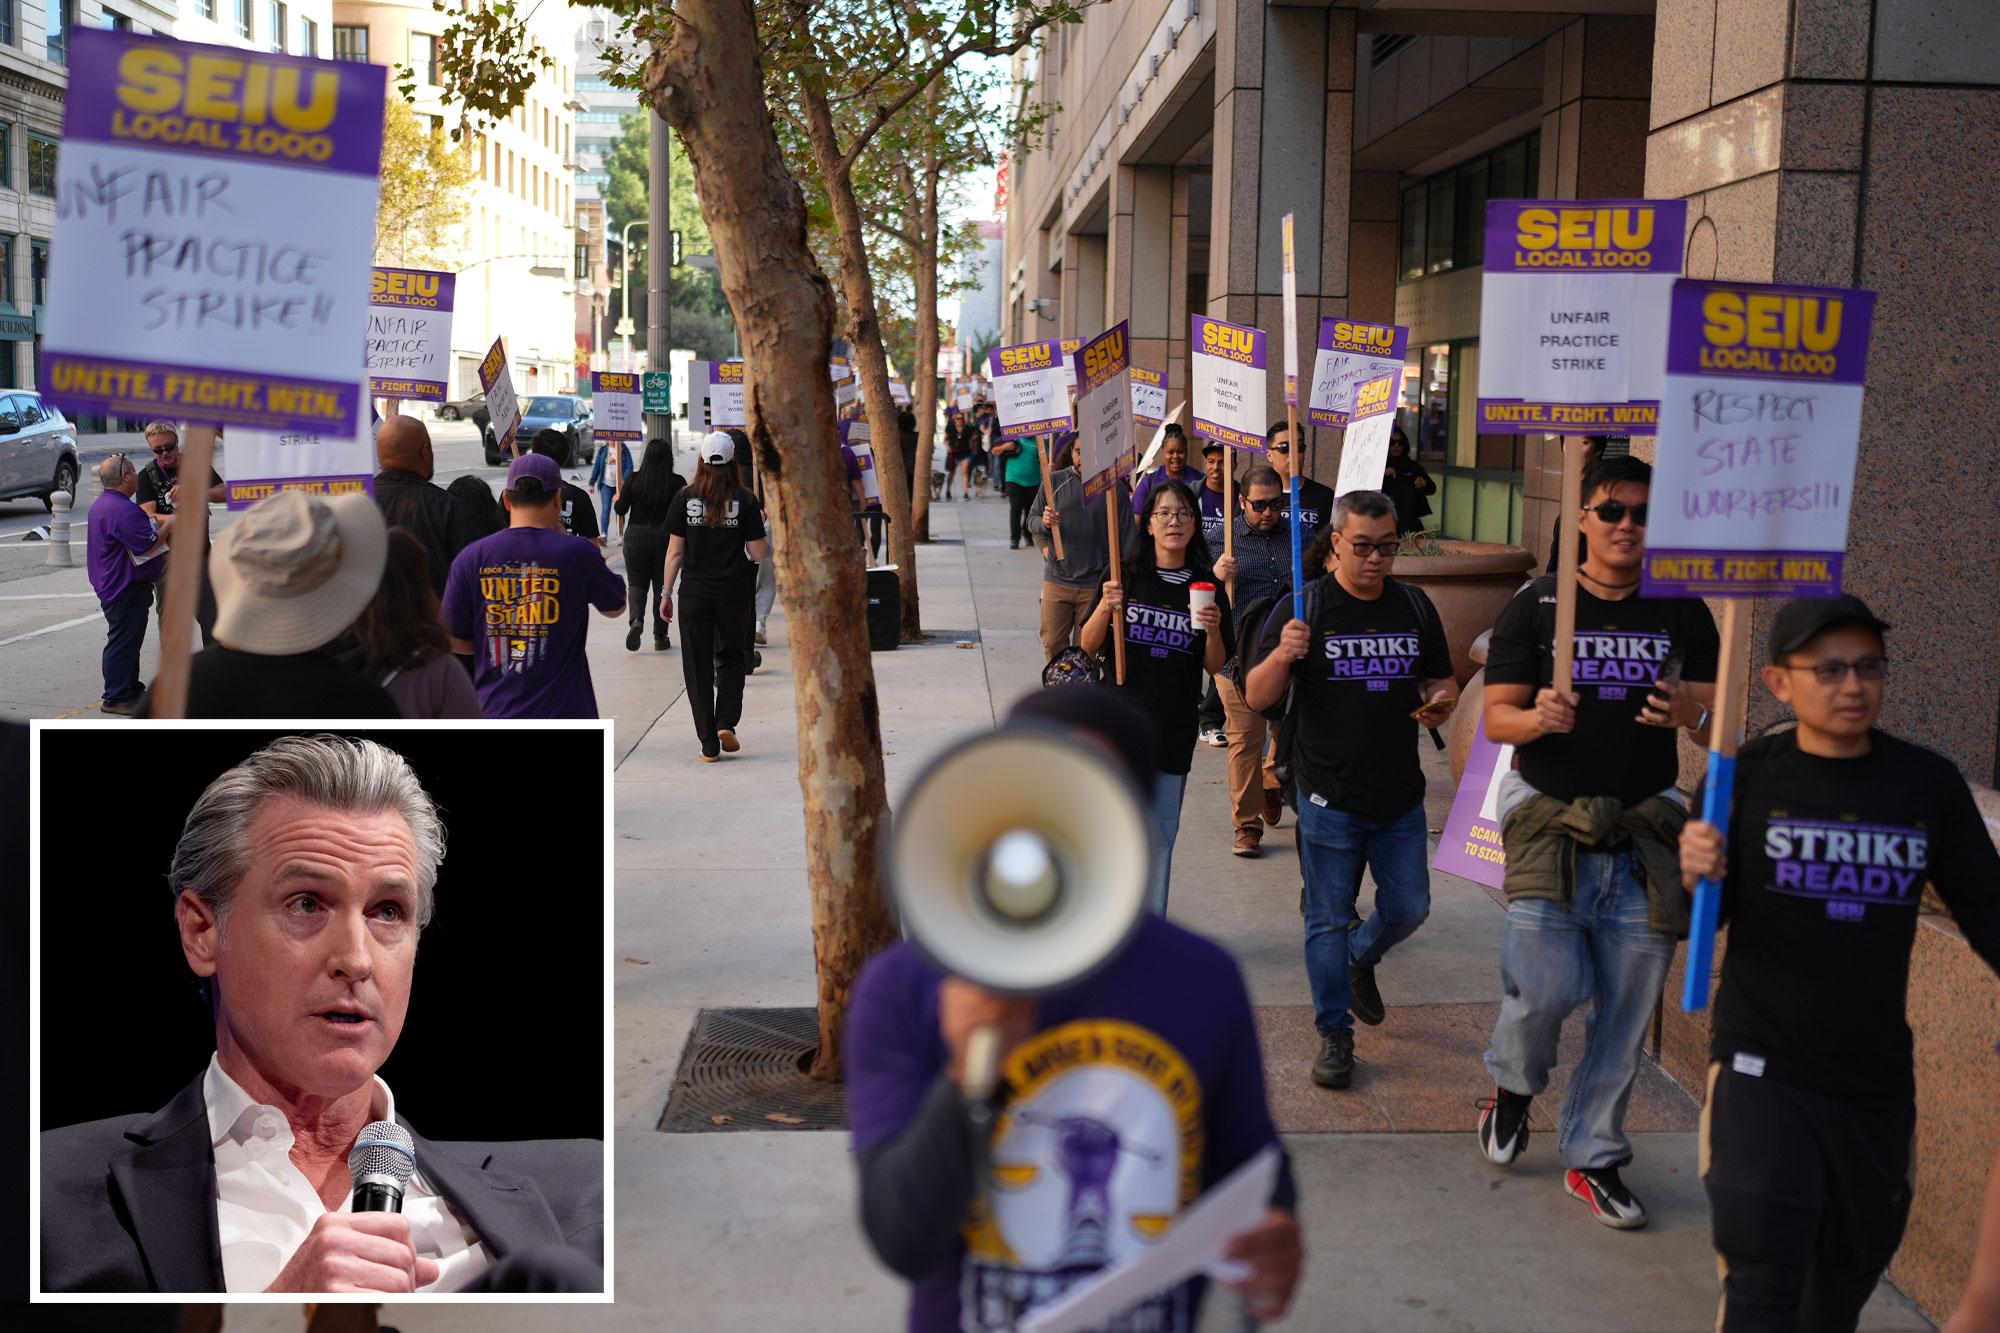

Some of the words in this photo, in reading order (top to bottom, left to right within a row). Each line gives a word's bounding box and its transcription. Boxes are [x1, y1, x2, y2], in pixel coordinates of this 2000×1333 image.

[116, 47, 341, 133] SEIU
[112, 108, 230, 149] LOCAL
[236, 126, 334, 162] 1000
[55, 162, 238, 225] UNFAIR
[1516, 209, 1655, 250] SEIU
[121, 228, 332, 286] PRACTICE
[1515, 251, 1588, 267] LOCAL
[1591, 251, 1651, 267] 1000
[370, 271, 439, 298] SEIU
[370, 294, 403, 304] OCAL
[403, 296, 437, 307] 1000
[0, 319, 33, 337] UILDING
[1550, 312, 1610, 324] UNFAIR
[1703, 291, 1844, 353] SEIU
[1203, 322, 1254, 354] SEIU
[1334, 322, 1395, 347] SEIU
[1540, 335, 1619, 347] PRACTICE
[367, 339, 429, 352] RACTICE
[1000, 343, 1051, 367] SEIU
[1061, 339, 1080, 351] EIU
[1084, 330, 1124, 377] SEIU
[1203, 343, 1229, 358] LOCAL
[1230, 349, 1253, 363] 1000
[1331, 341, 1364, 352] LOCAL
[1366, 344, 1392, 355] 1000
[719, 364, 743, 377] SE
[1002, 364, 1029, 373] LOCAL
[1030, 360, 1052, 368] 1000
[1326, 357, 1350, 374] FAIR
[1551, 358, 1606, 370] STRIKE
[1701, 347, 1775, 371] LOCAL
[1779, 352, 1837, 375] 1000
[600, 373, 633, 387] SEIU
[1013, 380, 1040, 389] RESPECT
[1216, 376, 1239, 389] UNFAIR
[1020, 390, 1036, 398] STATE
[1214, 387, 1243, 402] PRACTICE
[1357, 376, 1394, 408] SEIU
[1014, 398, 1045, 408] WORKERS
[1217, 401, 1238, 413] STRIKE
[1355, 405, 1371, 417] LOCAL
[1691, 389, 1820, 433] RESPECT
[1485, 405, 1547, 421] UNITE.
[1551, 407, 1610, 423] FIGHT.
[280, 434, 320, 446] STRIKE
[1697, 434, 1802, 476] STATE
[687, 498, 740, 518] SU
[480, 577, 560, 605] UNITED
[486, 595, 560, 625] STAND
[1129, 624, 1194, 649] READY
[1325, 637, 1420, 659] STRIKE
[1552, 636, 1671, 660] TRIKE
[1334, 657, 1415, 676] READY
[1470, 825, 1498, 844] SCAN
[1465, 841, 1478, 856] TO
[1478, 845, 1506, 865] SIGN
[1765, 825, 1928, 870] STRIKE
[1776, 861, 1916, 897] READY
